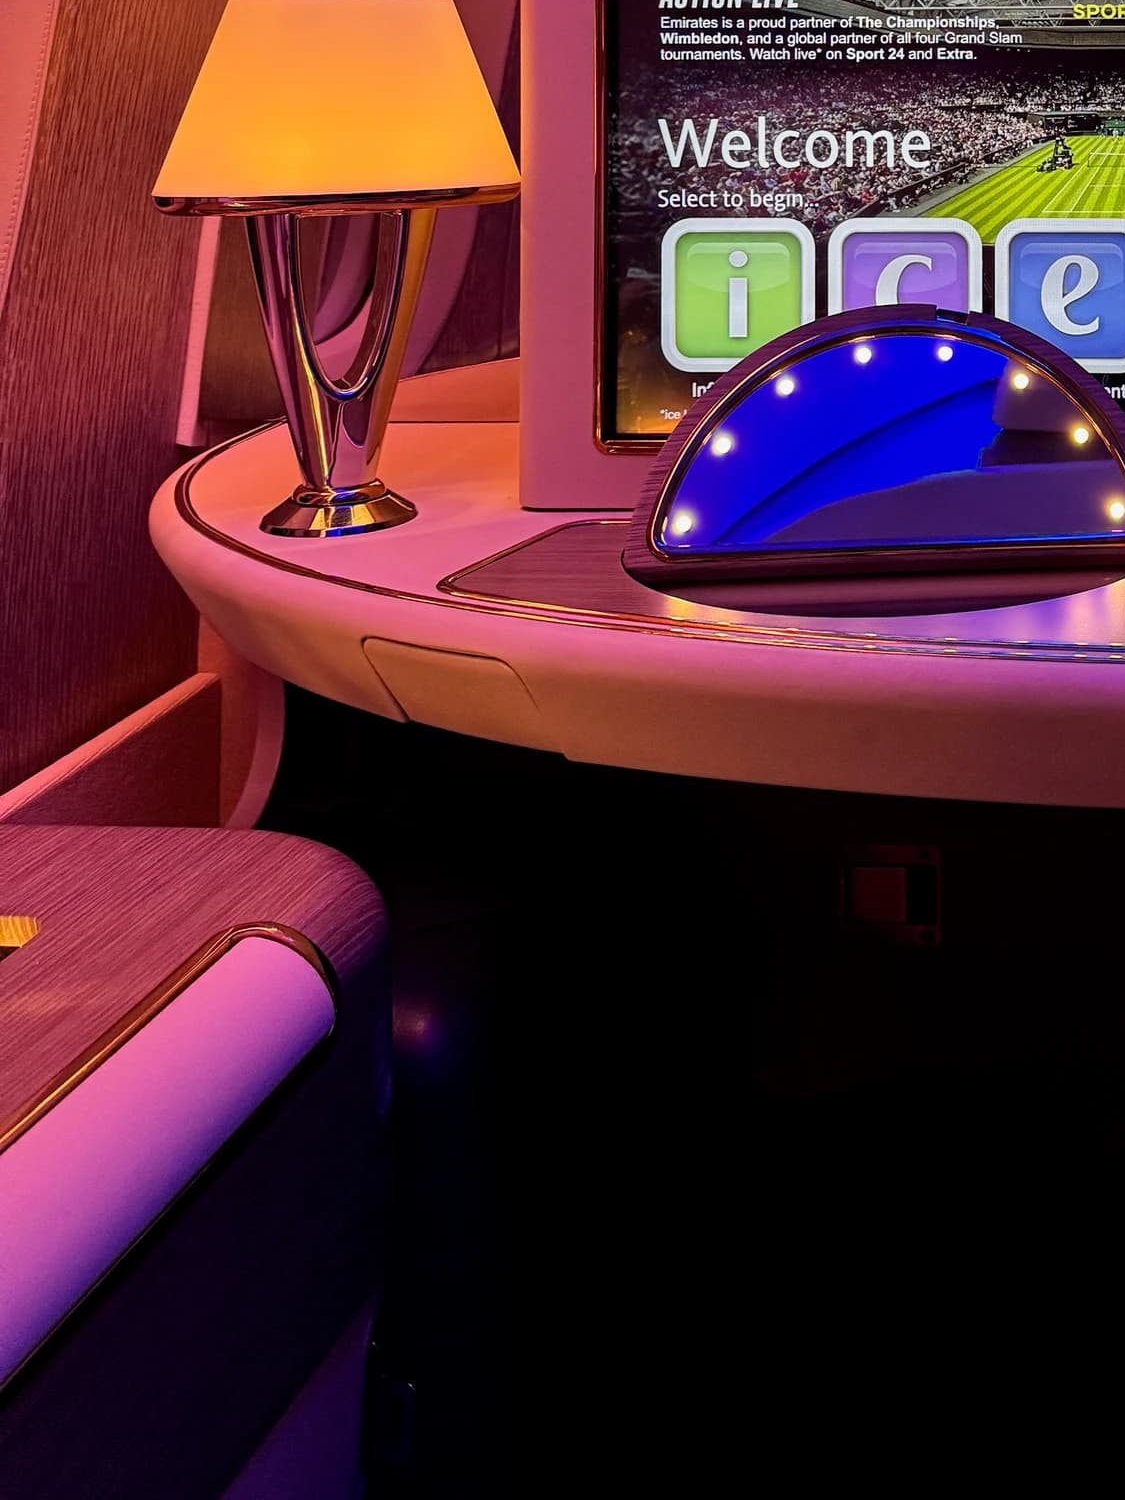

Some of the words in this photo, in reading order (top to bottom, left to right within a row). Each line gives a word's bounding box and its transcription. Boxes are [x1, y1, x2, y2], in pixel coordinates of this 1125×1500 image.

[660, 16, 719, 29] Emirates
[722, 16, 733, 29] is
[736, 19, 745, 29] a
[748, 16, 787, 33] proud
[790, 17, 837, 33] partner
[839, 16, 855, 29] of
[856, 16, 883, 29] The
[886, 16, 1000, 33] Championships,
[660, 32, 743, 48] Wimbledon,
[747, 32, 771, 45] and
[775, 35, 783, 45] a
[787, 31, 827, 49] global
[830, 32, 878, 49] partner
[880, 31, 896, 45] of
[896, 31, 911, 45] all
[914, 31, 943, 45] four
[944, 31, 986, 45] Grand
[989, 31, 1023, 45] Slam
[660, 48, 746, 61] tournaments.
[750, 48, 791, 61] Watch
[826, 51, 843, 61] on
[846, 48, 885, 64] Sport
[887, 48, 905, 60] 24
[908, 48, 933, 61] and
[936, 48, 977, 61] Extra.
[657, 115, 932, 169] Welcome
[657, 189, 717, 209] Select
[722, 190, 744, 209] to
[750, 189, 820, 212] begin...
[727, 249, 749, 338] i
[1039, 253, 1101, 336] e
